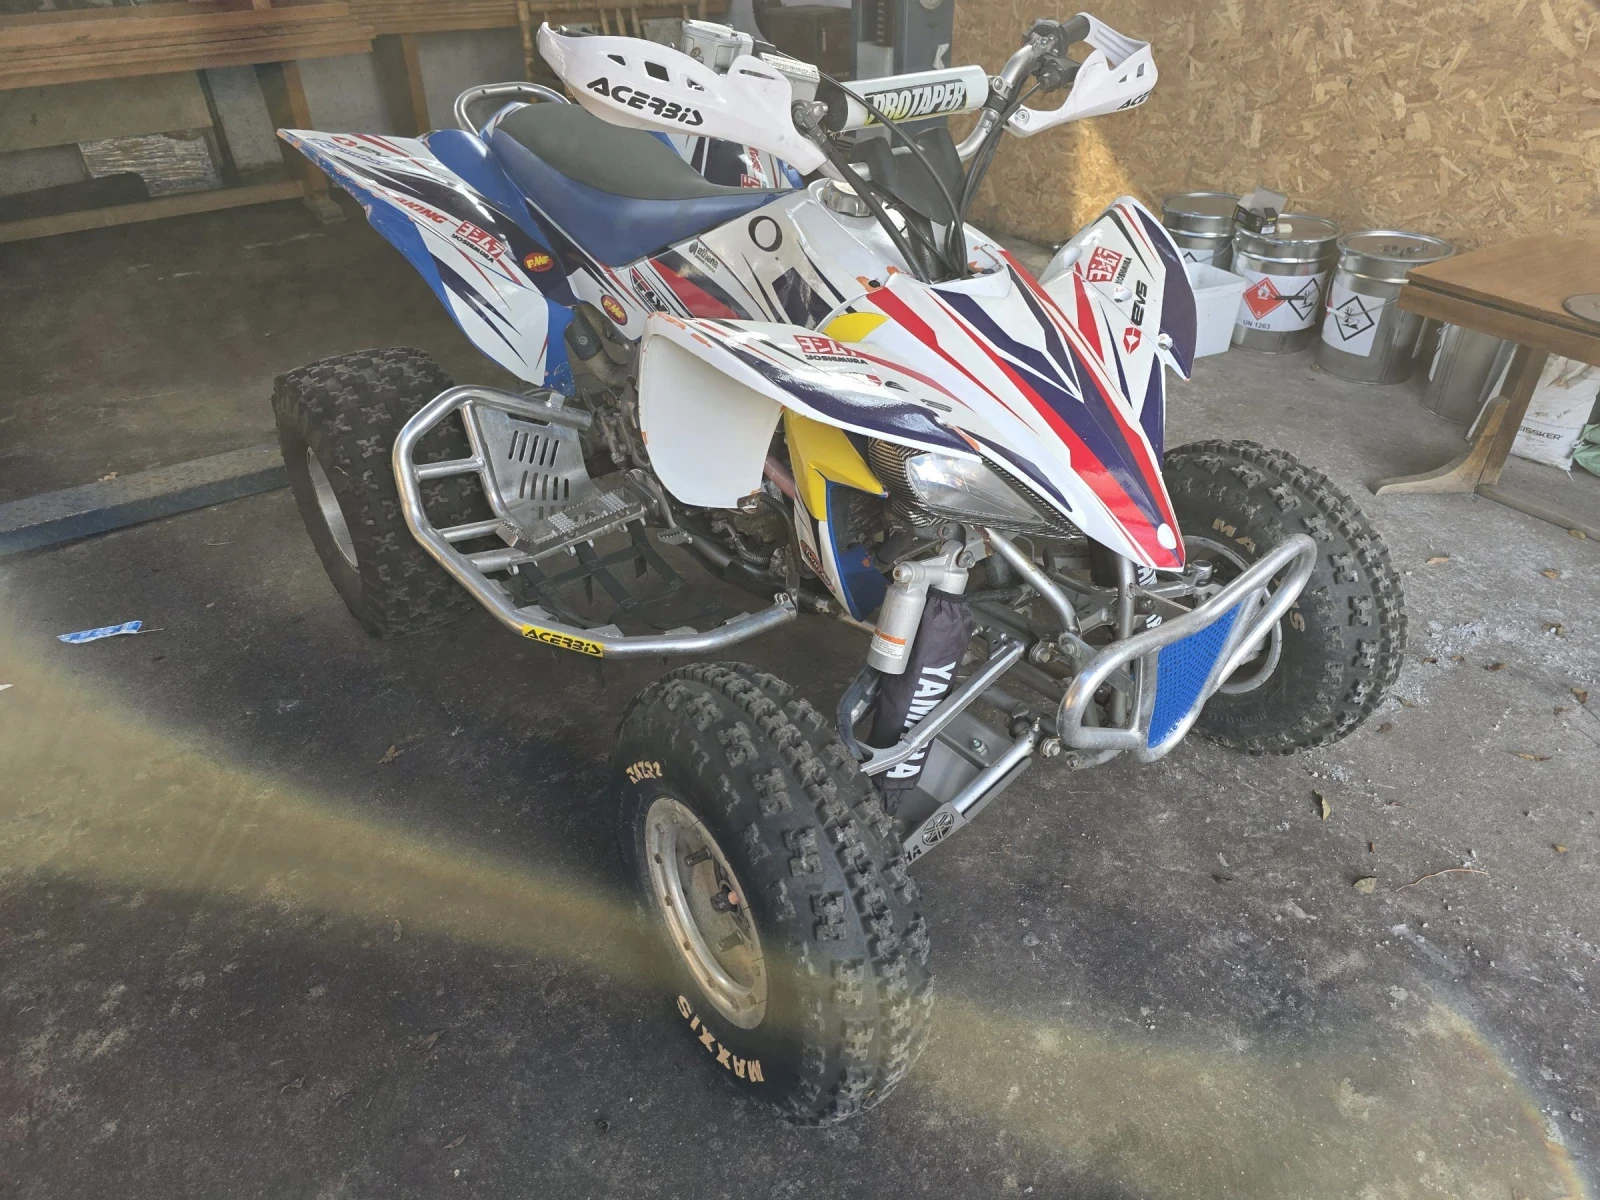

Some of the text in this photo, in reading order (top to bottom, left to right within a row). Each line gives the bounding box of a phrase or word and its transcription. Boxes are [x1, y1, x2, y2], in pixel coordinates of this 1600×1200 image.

[451, 232, 495, 264] YOSHIMURA
[526, 254, 550, 269] FMF
[603, 299, 625, 319] FMF
[1243, 319, 1271, 330] UN 1263
[804, 354, 868, 365] YOSHIMURA
[675, 994, 765, 1083] MAXXIS
